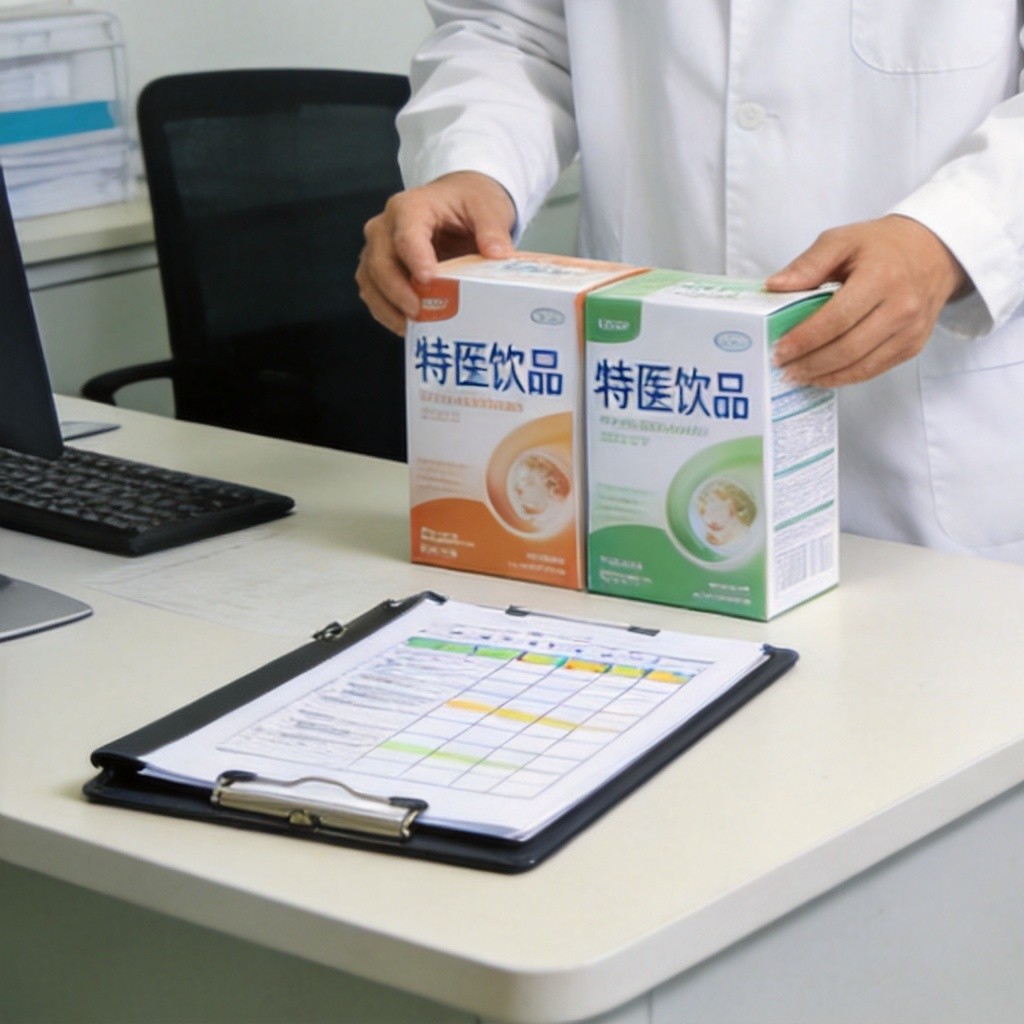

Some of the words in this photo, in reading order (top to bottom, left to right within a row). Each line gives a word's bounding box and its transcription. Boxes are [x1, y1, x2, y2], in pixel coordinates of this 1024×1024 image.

[414, 336, 563, 396] 特医饮品
[593, 359, 749, 419] 特医饮品
